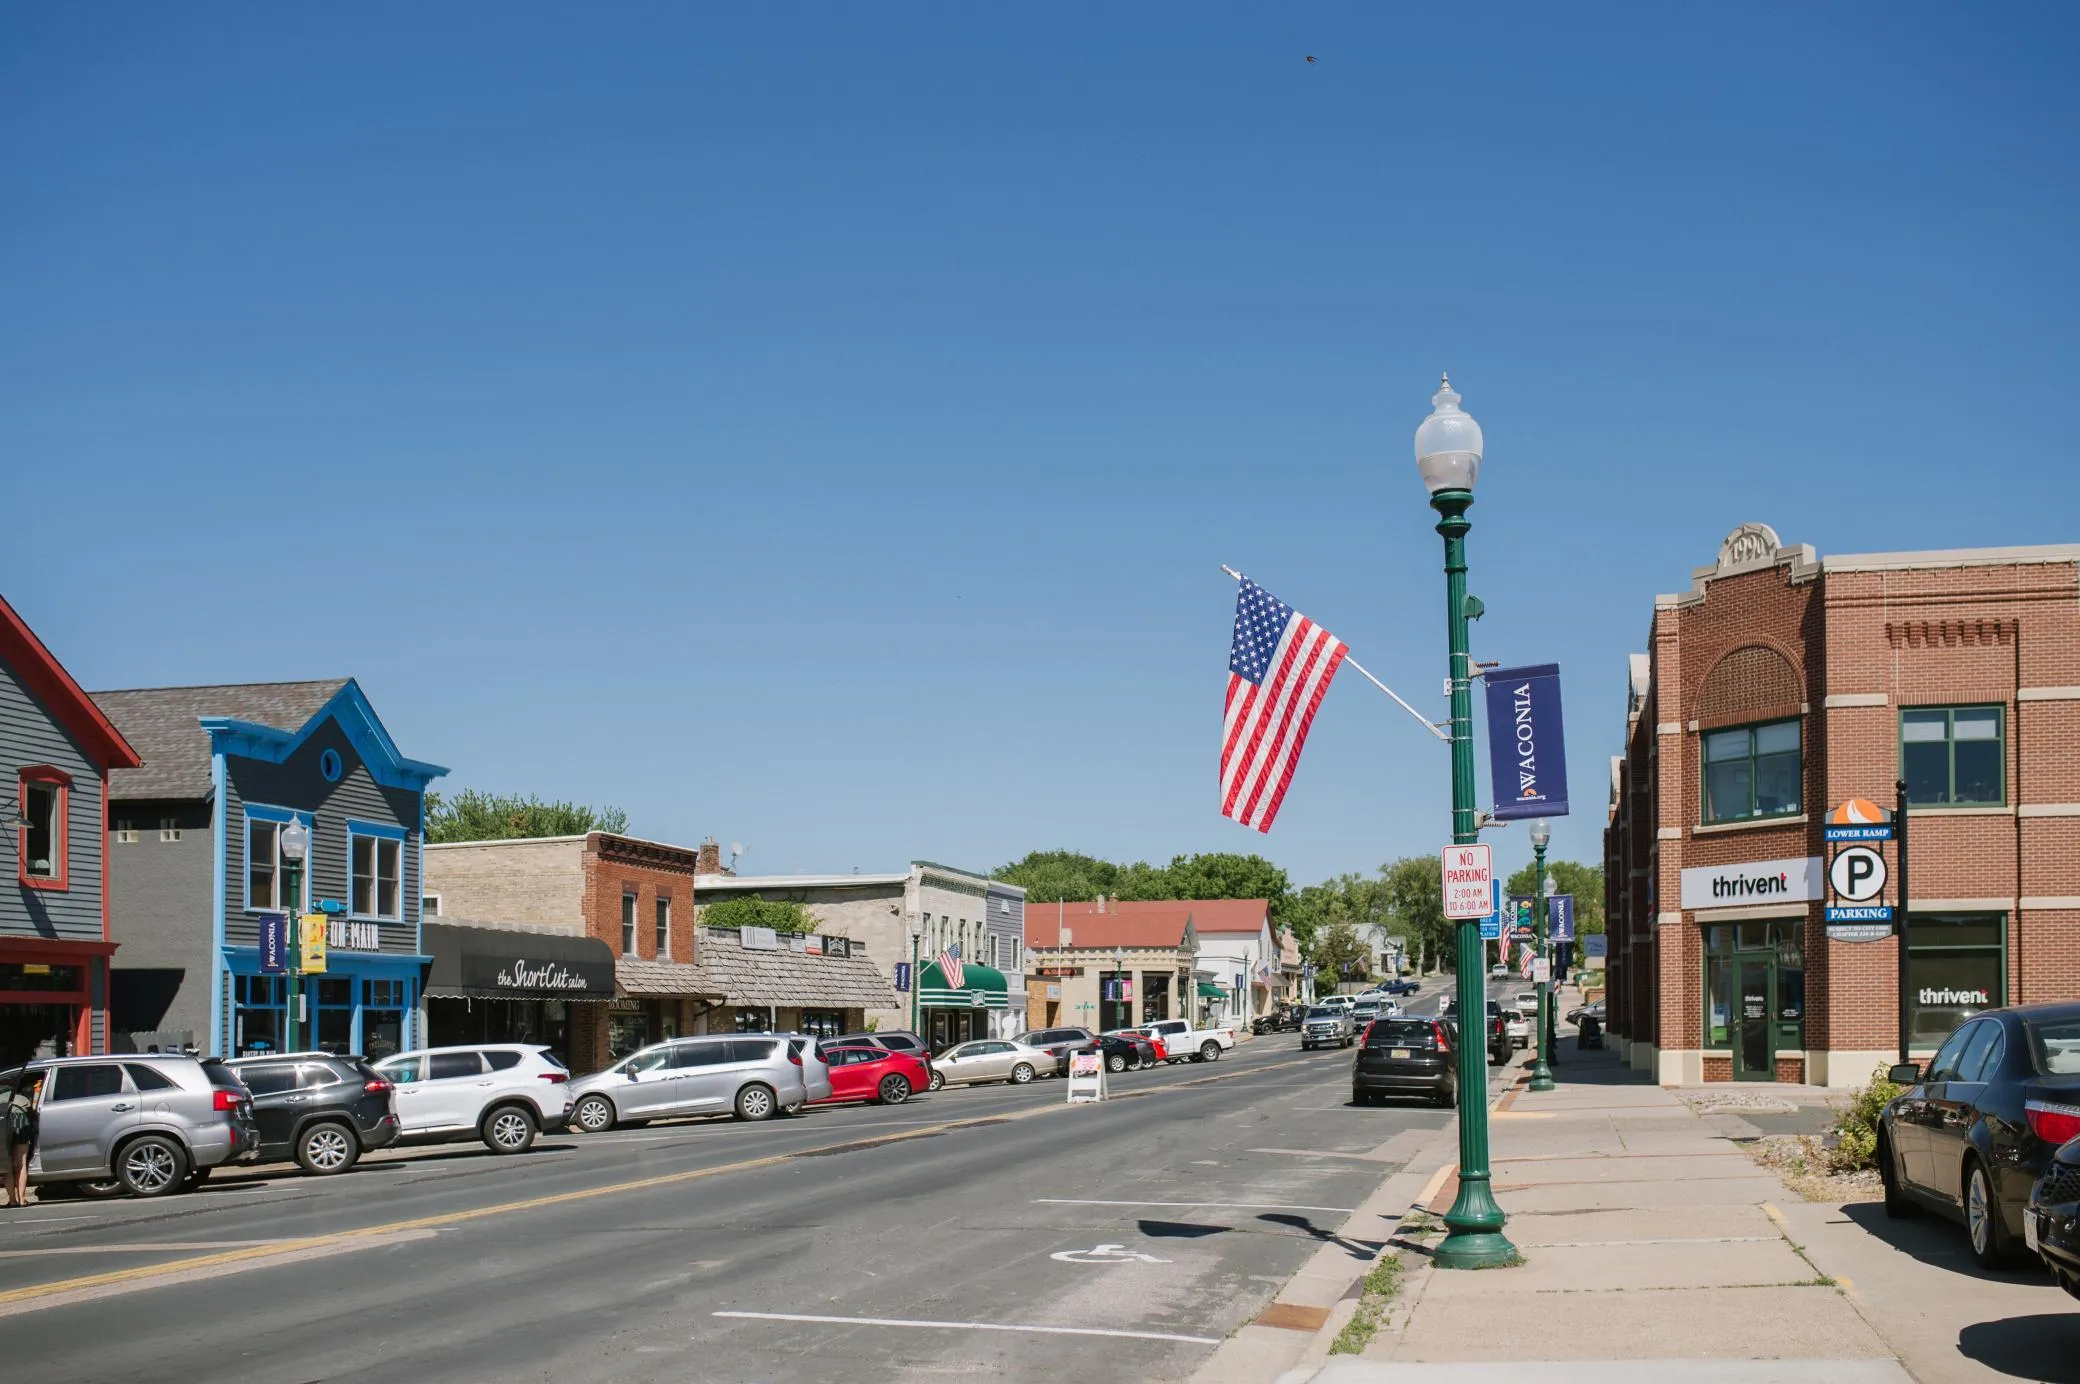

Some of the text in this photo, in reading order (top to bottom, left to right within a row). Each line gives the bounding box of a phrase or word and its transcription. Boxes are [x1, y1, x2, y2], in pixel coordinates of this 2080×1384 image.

[1514, 682, 1537, 791] WACONIA
[1827, 828, 1889, 839] LOWER RAMP
[1459, 852, 1474, 866] NO
[1447, 868, 1488, 884] PARKING
[1713, 872, 1787, 897] thrivent
[1848, 855, 1874, 895] P
[1454, 888, 1483, 899] 2:00 AM
[1449, 900, 1489, 911] TO 6:00 AM
[1830, 908, 1888, 919] PARKING
[1558, 899, 1566, 935] WACONIA
[268, 921, 276, 964] WACONIA
[330, 921, 346, 947] ON
[351, 922, 379, 949] MAIN
[497, 968, 512, 986] the
[567, 973, 587, 989] salon
[1919, 987, 1988, 1004] thrivent
